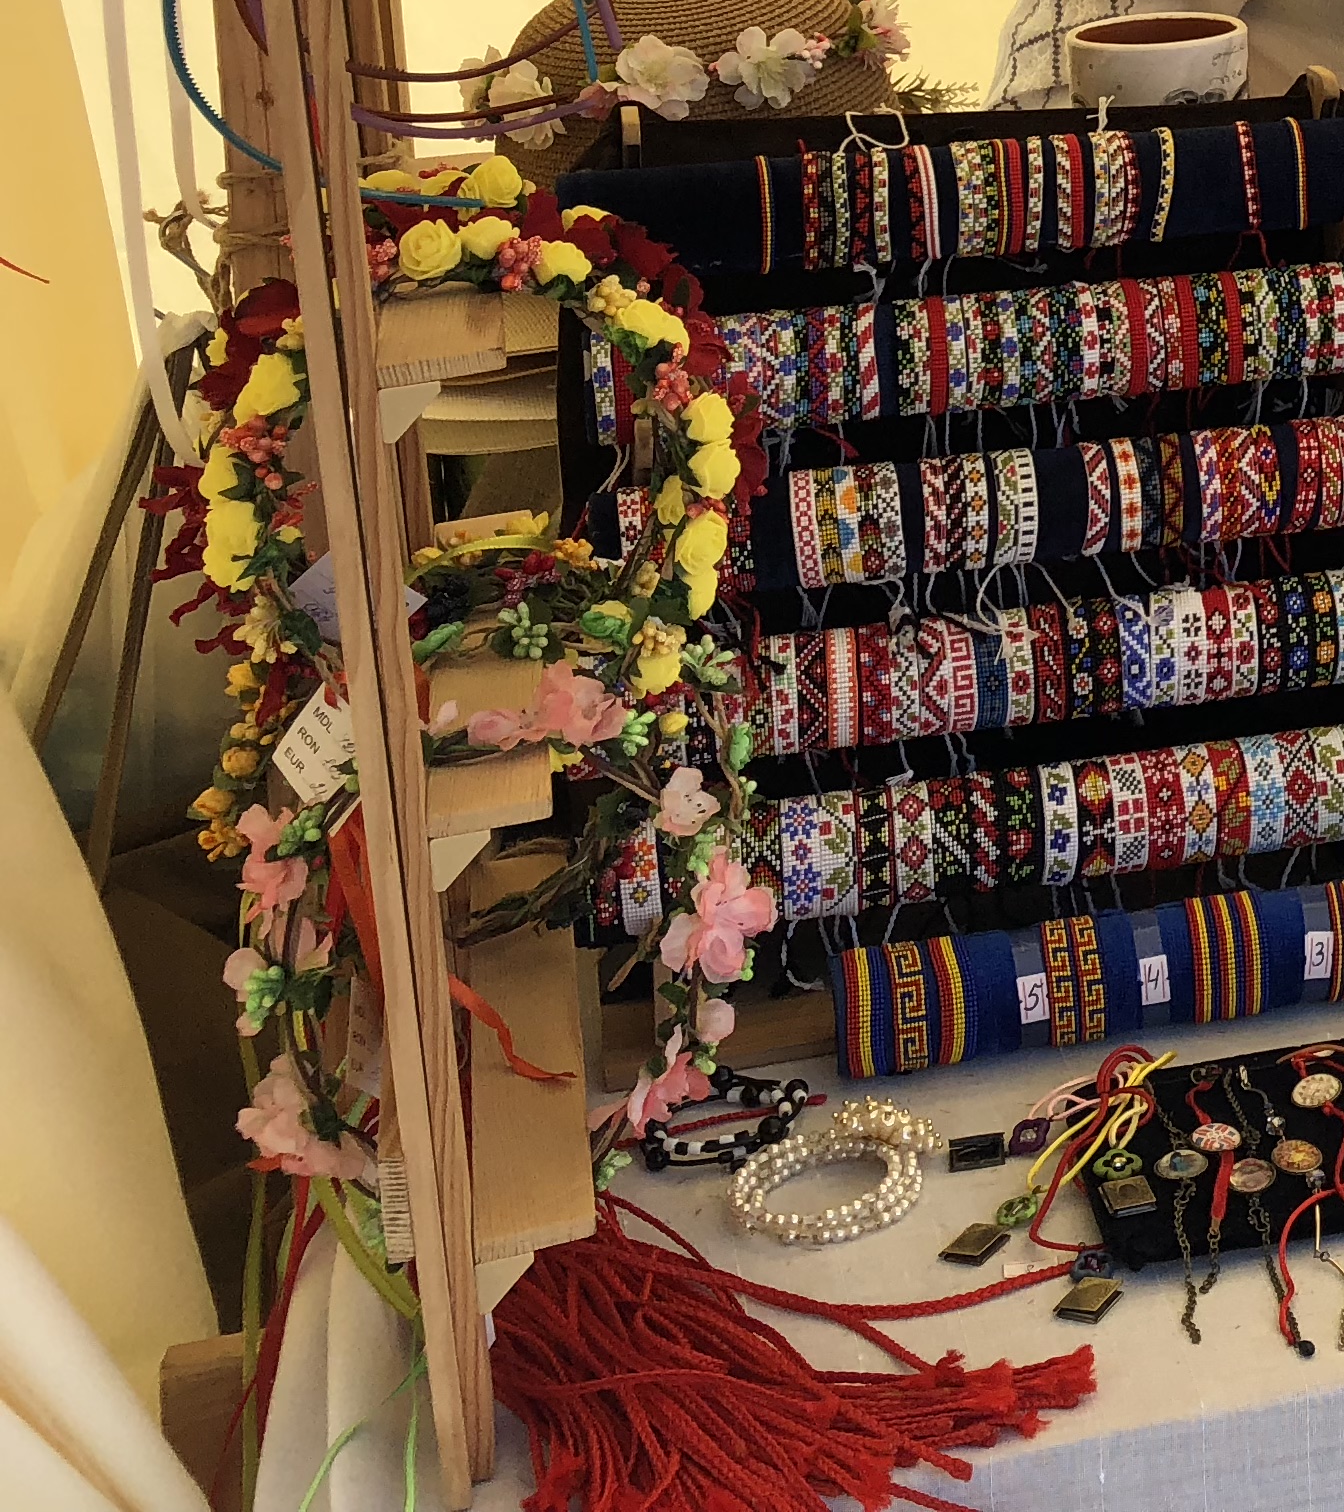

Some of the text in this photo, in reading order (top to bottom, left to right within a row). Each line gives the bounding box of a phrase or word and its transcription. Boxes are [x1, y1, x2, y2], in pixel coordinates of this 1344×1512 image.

[312, 706, 335, 734] MDL
[296, 725, 321, 755] RON
[283, 746, 305, 775] EUR
[1312, 941, 1325, 967] 3
[1147, 963, 1160, 991] 4
[1023, 982, 1044, 1012] 5
